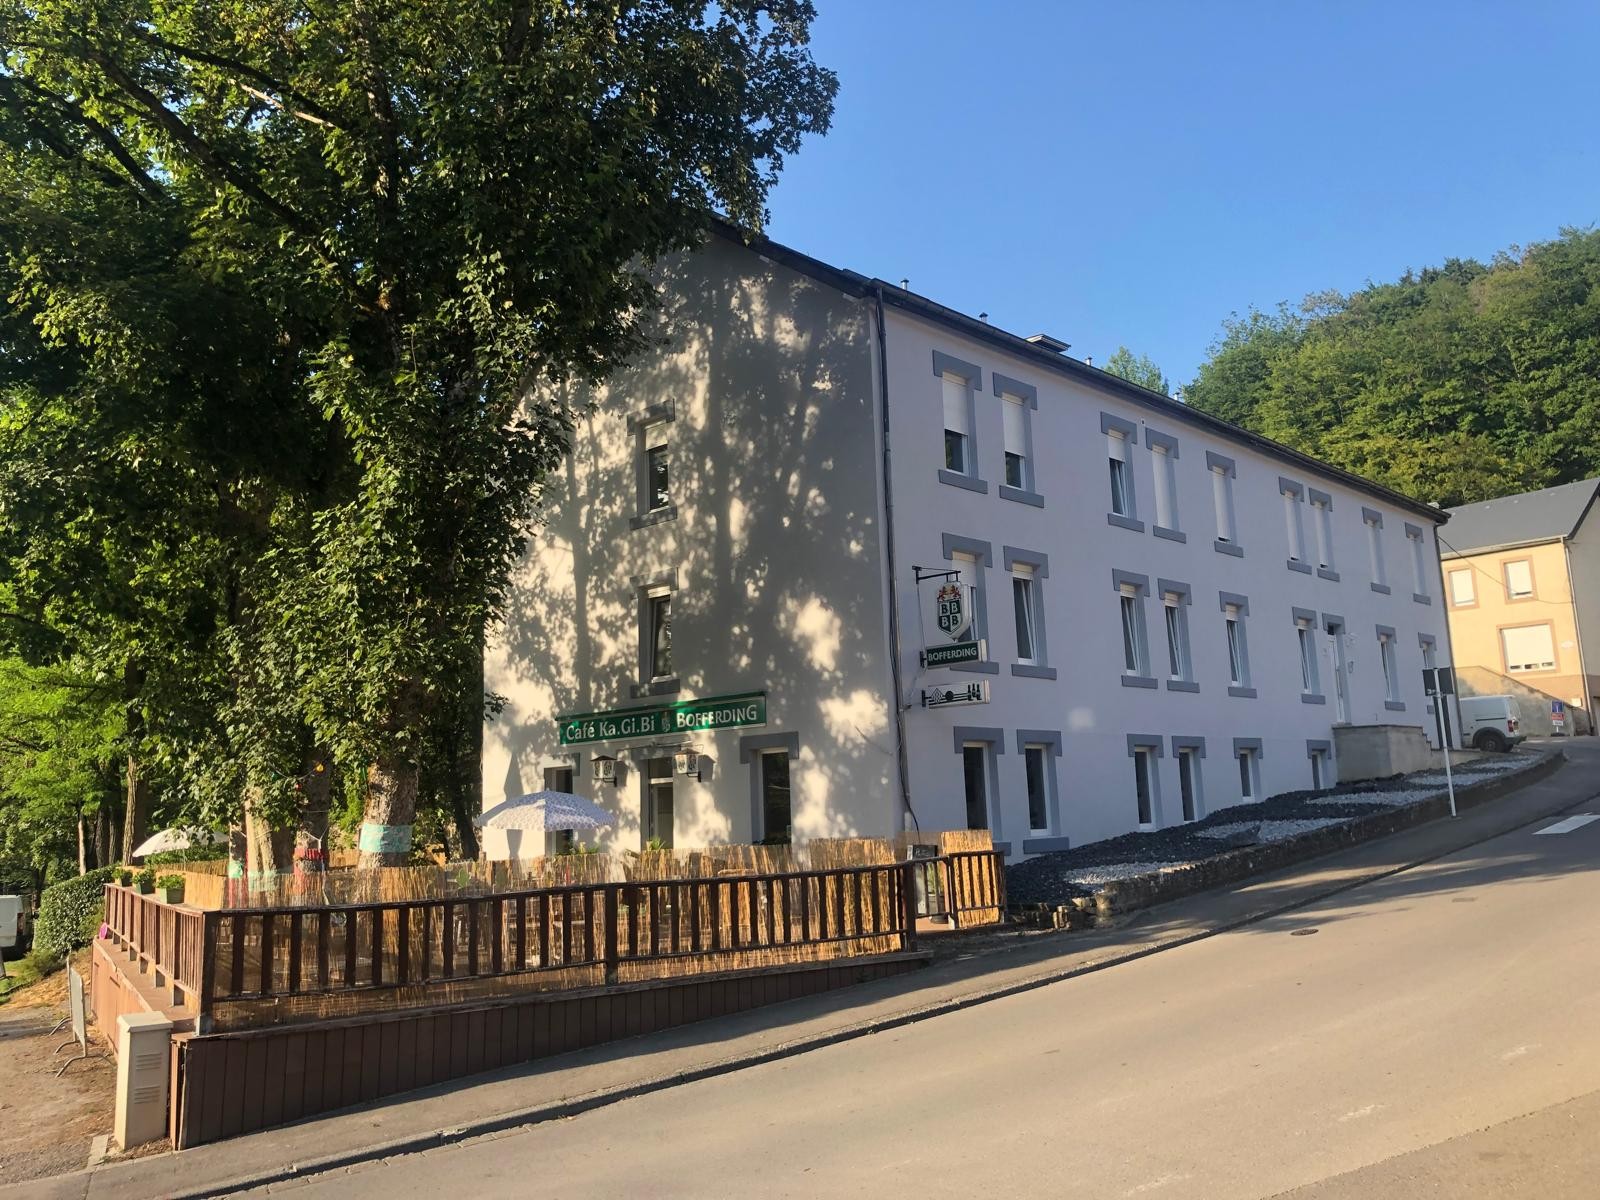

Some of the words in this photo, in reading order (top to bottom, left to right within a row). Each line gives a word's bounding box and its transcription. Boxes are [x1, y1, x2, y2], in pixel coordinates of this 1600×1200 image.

[928, 647, 977, 661] BOFFERDING
[566, 721, 595, 740] Café
[599, 716, 655, 737] Ka.Gi.Bi
[676, 704, 758, 728] BOFFERDING
